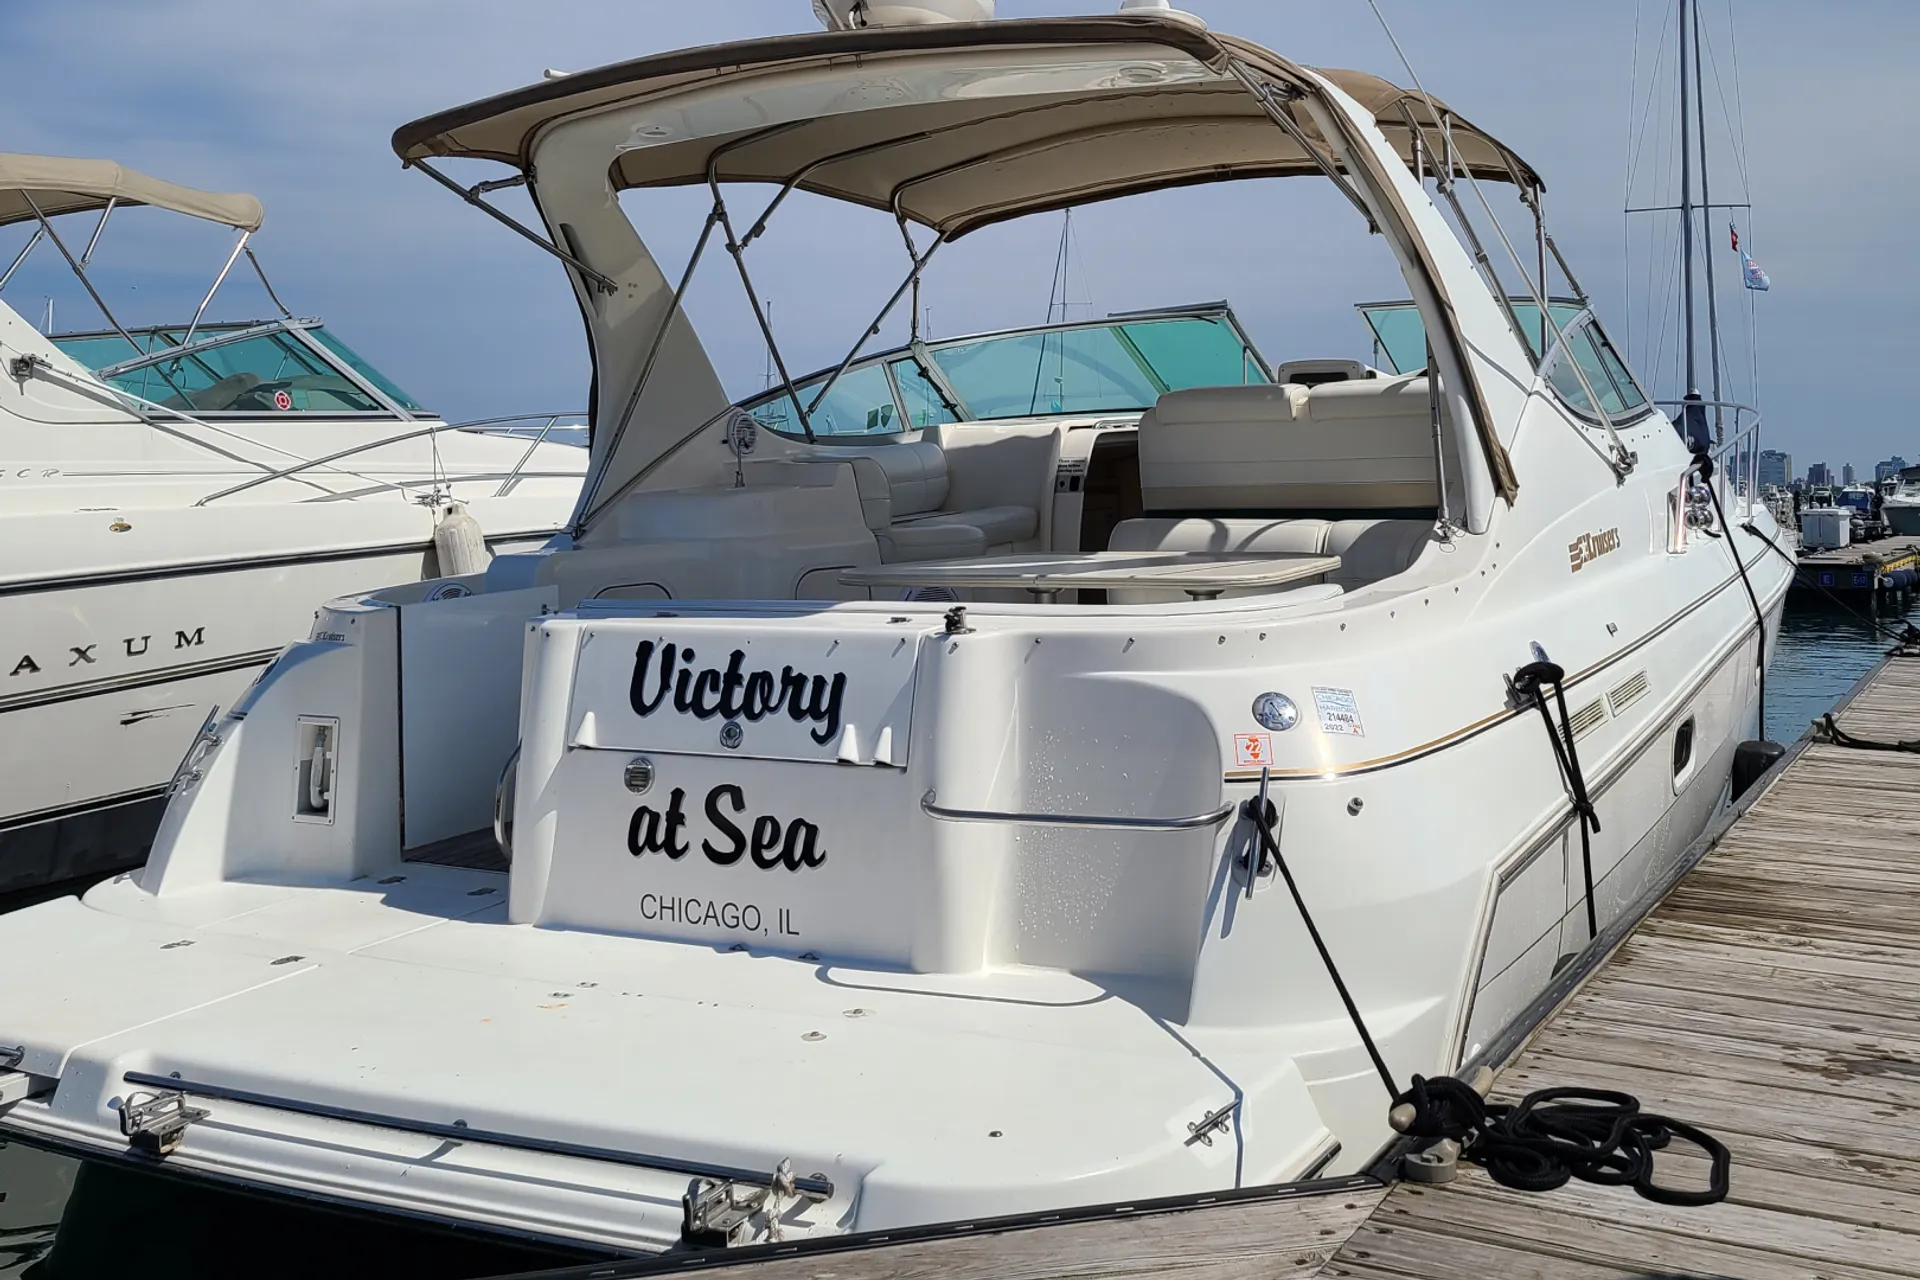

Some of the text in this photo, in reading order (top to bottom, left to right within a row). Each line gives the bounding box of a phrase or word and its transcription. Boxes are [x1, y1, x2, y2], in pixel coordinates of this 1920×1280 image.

[10, 627, 206, 676] AXUM
[629, 640, 847, 745] Victory
[627, 784, 827, 872] at Sea
[640, 894, 800, 937] CHICAGO, IL
